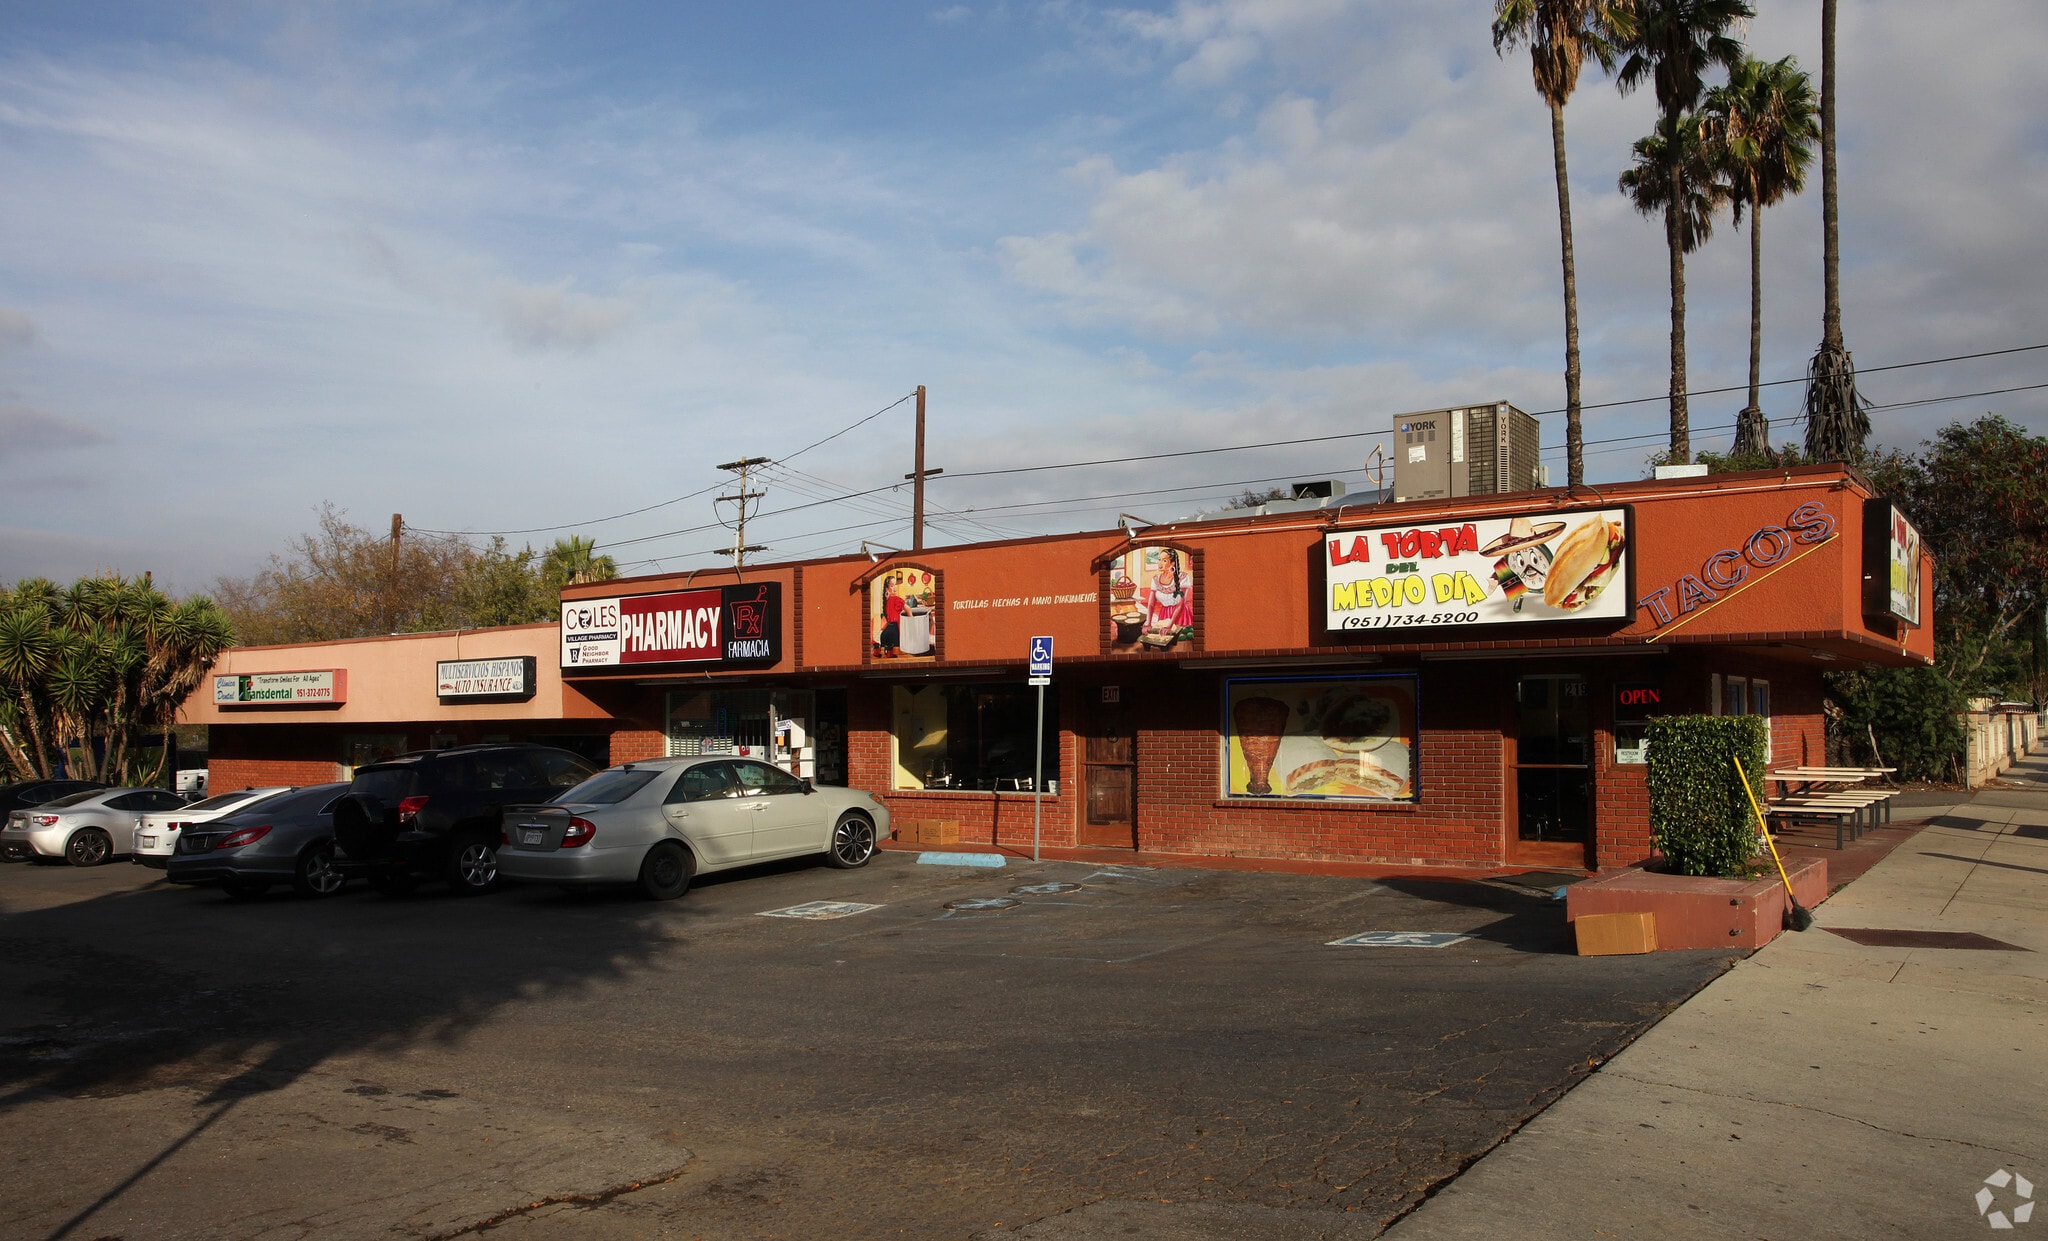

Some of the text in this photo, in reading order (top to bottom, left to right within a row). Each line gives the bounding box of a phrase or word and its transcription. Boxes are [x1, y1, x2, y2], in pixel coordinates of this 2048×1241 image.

[1410, 421, 1436, 431] YORK
[1329, 523, 1478, 567] LA TORTA
[1386, 561, 1419, 574] DEL
[1639, 501, 1836, 624] TACOS
[1333, 574, 1426, 611] MEDIO
[953, 599, 989, 610] TORTILLAS
[992, 597, 1021, 607] HECHAS
[1023, 597, 1029, 606] A
[1032, 595, 1052, 605] MANO
[566, 605, 617, 630] COLES
[589, 632, 617, 641] PHARMACY
[621, 606, 720, 653] PHARMACY
[728, 639, 770, 658] FARMACIA
[441, 660, 523, 680] MULTISERVICIOS HISPANOS
[296, 688, 331, 697] 951-372-0775
[454, 677, 512, 693] AUTO INSURANCE
[217, 690, 235, 700] Dental
[1103, 688, 1118, 701] EXIT
[1620, 689, 1660, 705] OPEN
